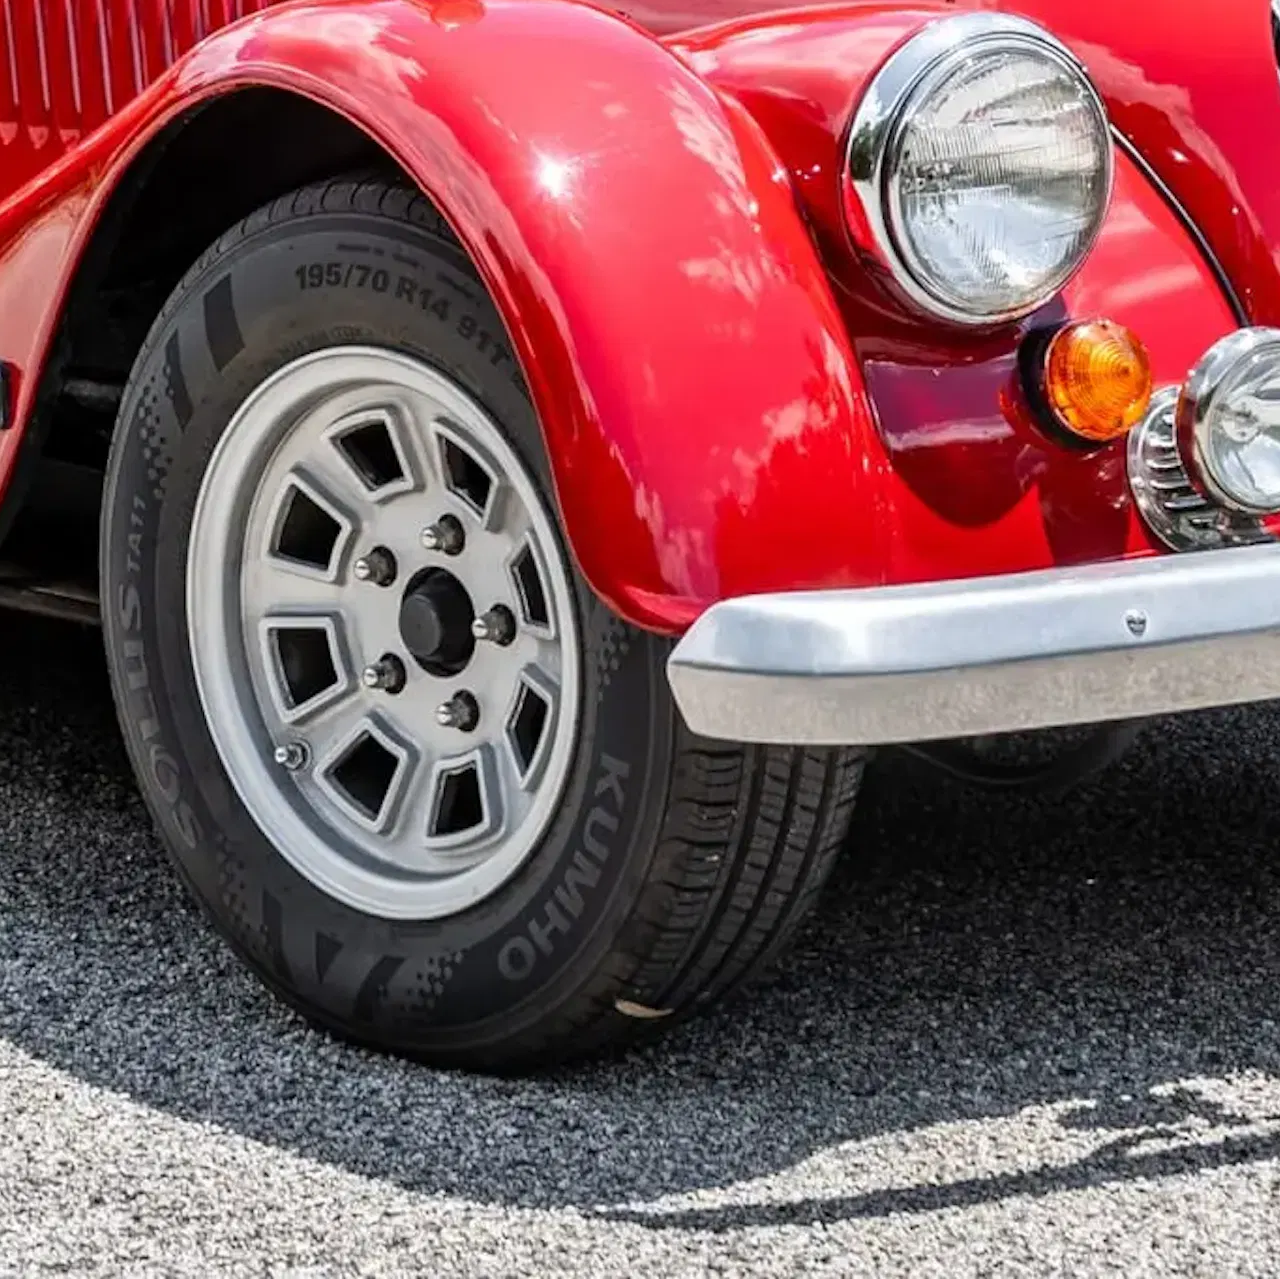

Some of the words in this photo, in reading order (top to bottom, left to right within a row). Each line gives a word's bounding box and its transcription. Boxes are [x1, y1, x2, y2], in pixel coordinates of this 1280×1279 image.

[295, 261, 389, 292] 195/70
[394, 275, 451, 322] R14
[455, 314, 509, 367] 91T
[126, 493, 147, 573] TA11
[497, 751, 632, 982] KUMHO
